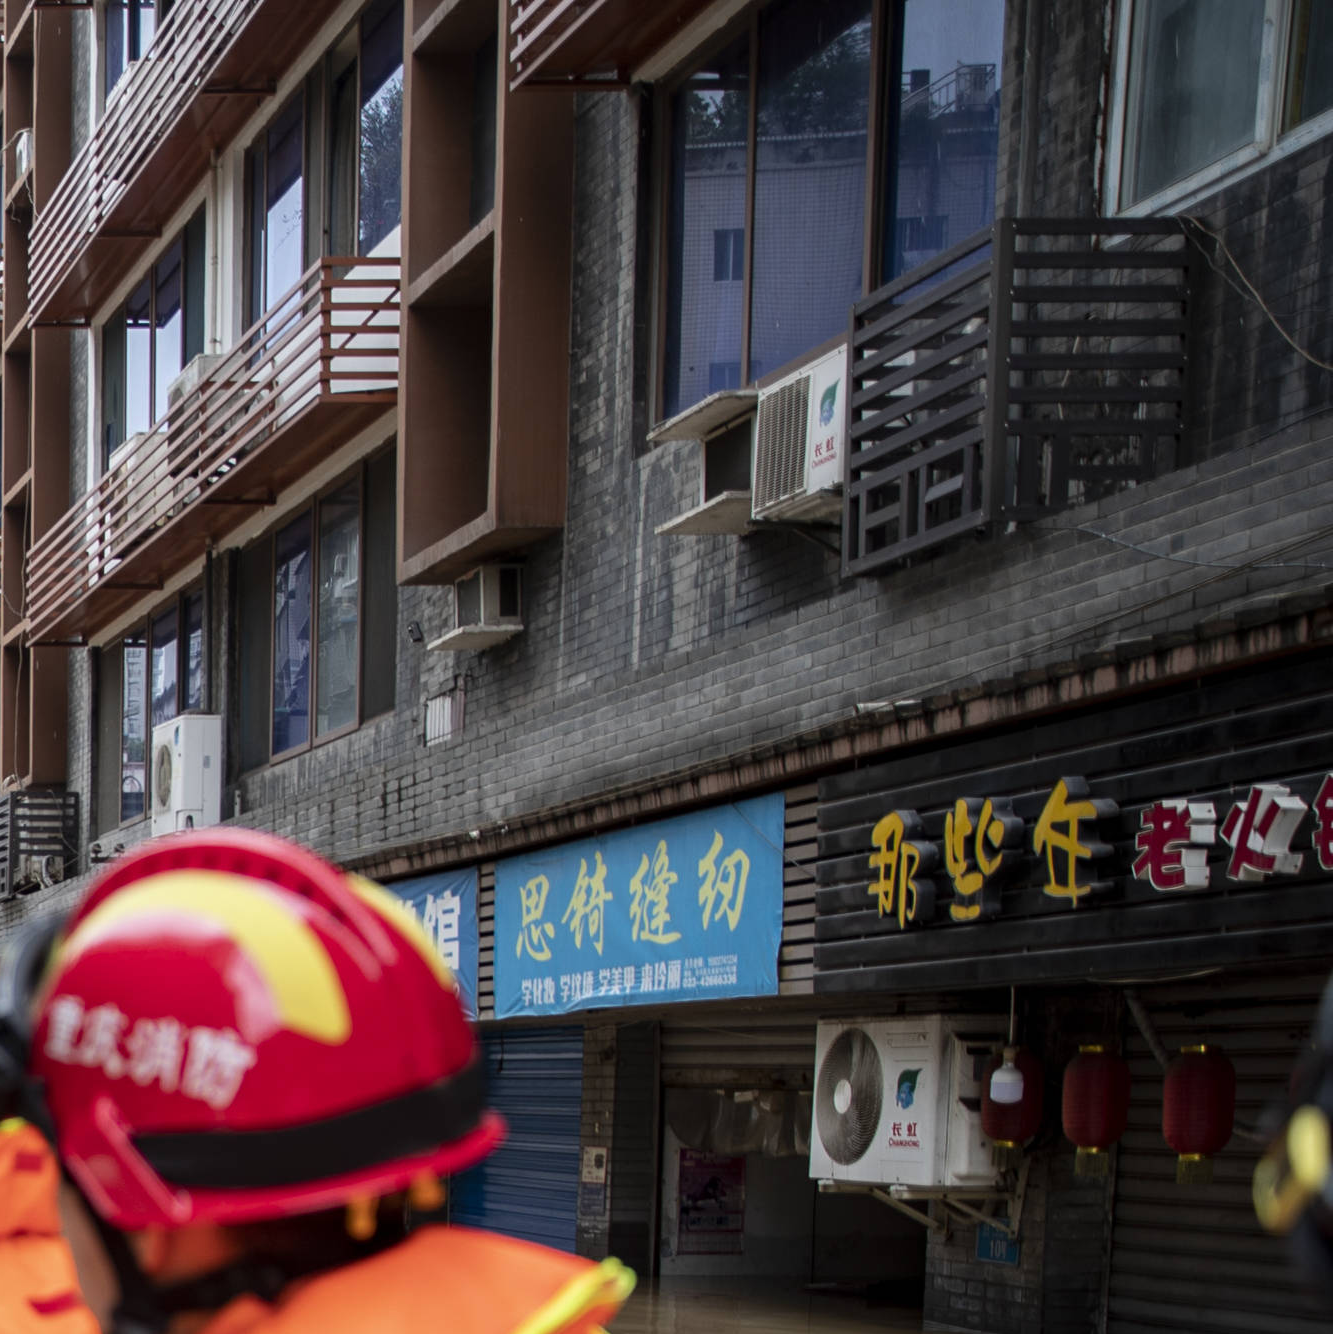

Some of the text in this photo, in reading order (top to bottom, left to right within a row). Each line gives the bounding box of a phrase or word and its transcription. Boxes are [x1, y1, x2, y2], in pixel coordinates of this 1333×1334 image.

[521, 976, 555, 1006] 学化妆
[599, 966, 635, 995] 学美甲
[892, 1122, 917, 1136] 长虹
